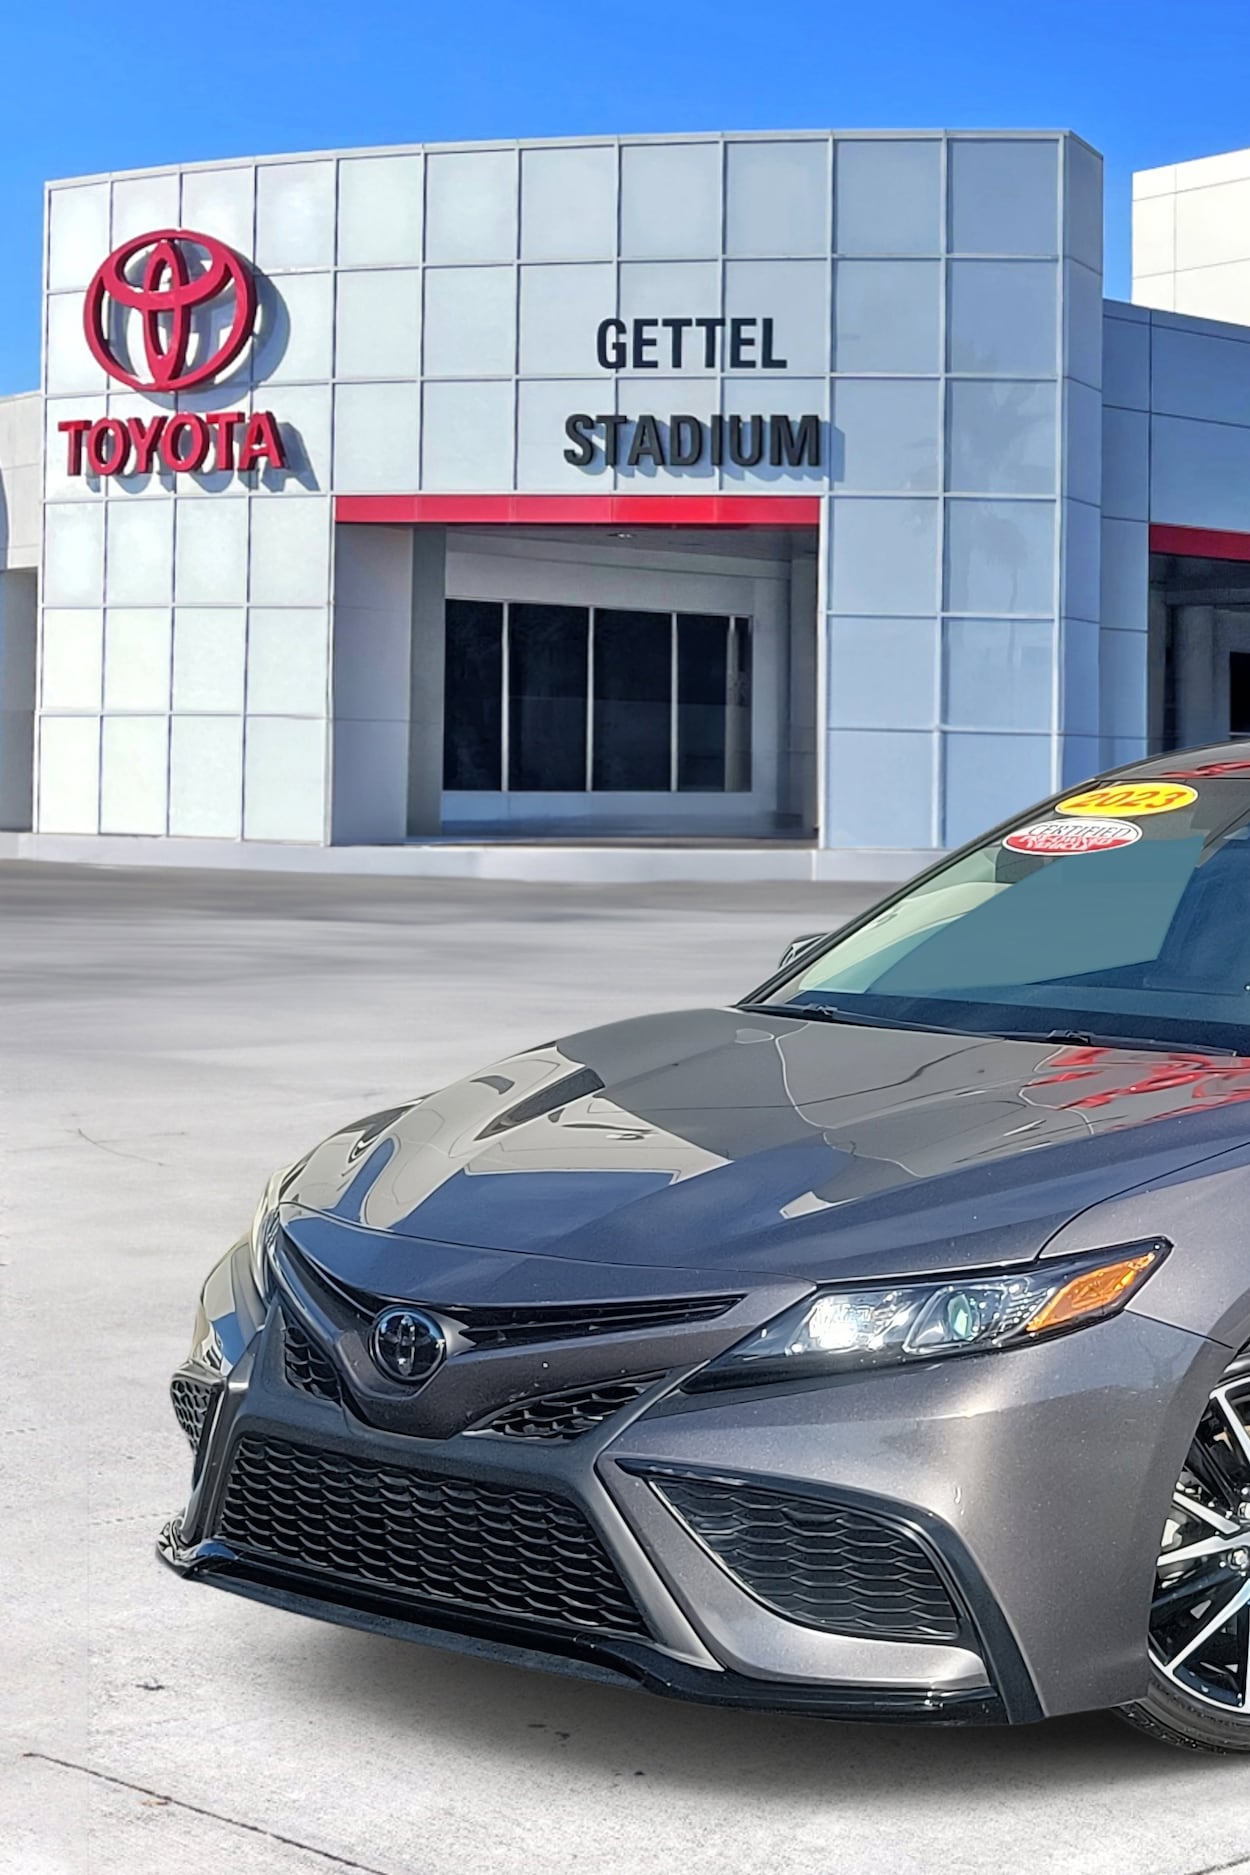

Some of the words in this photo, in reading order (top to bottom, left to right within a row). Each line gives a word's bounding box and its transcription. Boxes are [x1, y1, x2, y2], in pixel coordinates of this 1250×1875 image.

[597, 318, 788, 369] GETTEL
[58, 411, 285, 476] TOYOTA
[563, 413, 822, 467] STADIUM
[1065, 791, 1187, 809] 2023
[1028, 824, 1132, 837] CERTIFIED
